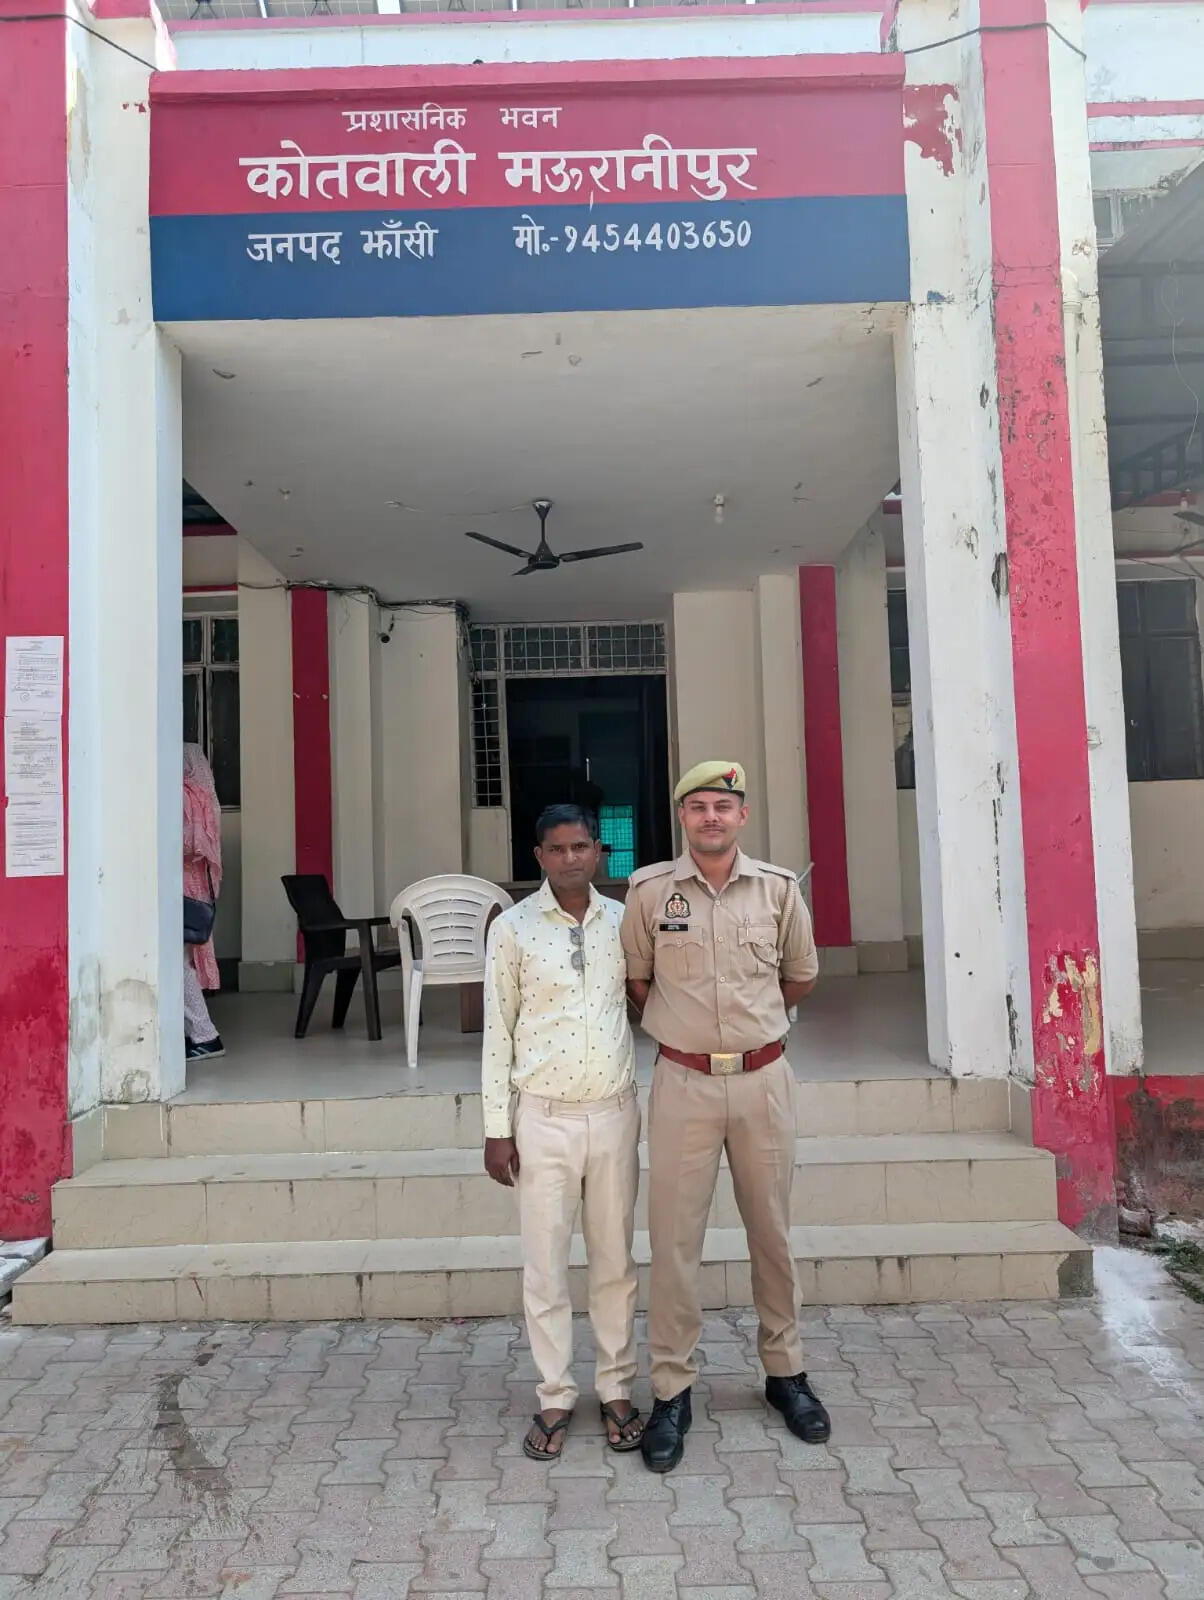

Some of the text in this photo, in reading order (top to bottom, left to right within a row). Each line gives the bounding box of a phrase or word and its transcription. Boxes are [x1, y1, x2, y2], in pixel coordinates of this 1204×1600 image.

[341, 102, 563, 132] प्रशासनिक भवन
[238, 133, 758, 202] कोतवाली मऊरानीपुर
[246, 219, 440, 265] जनपद झाँसी
